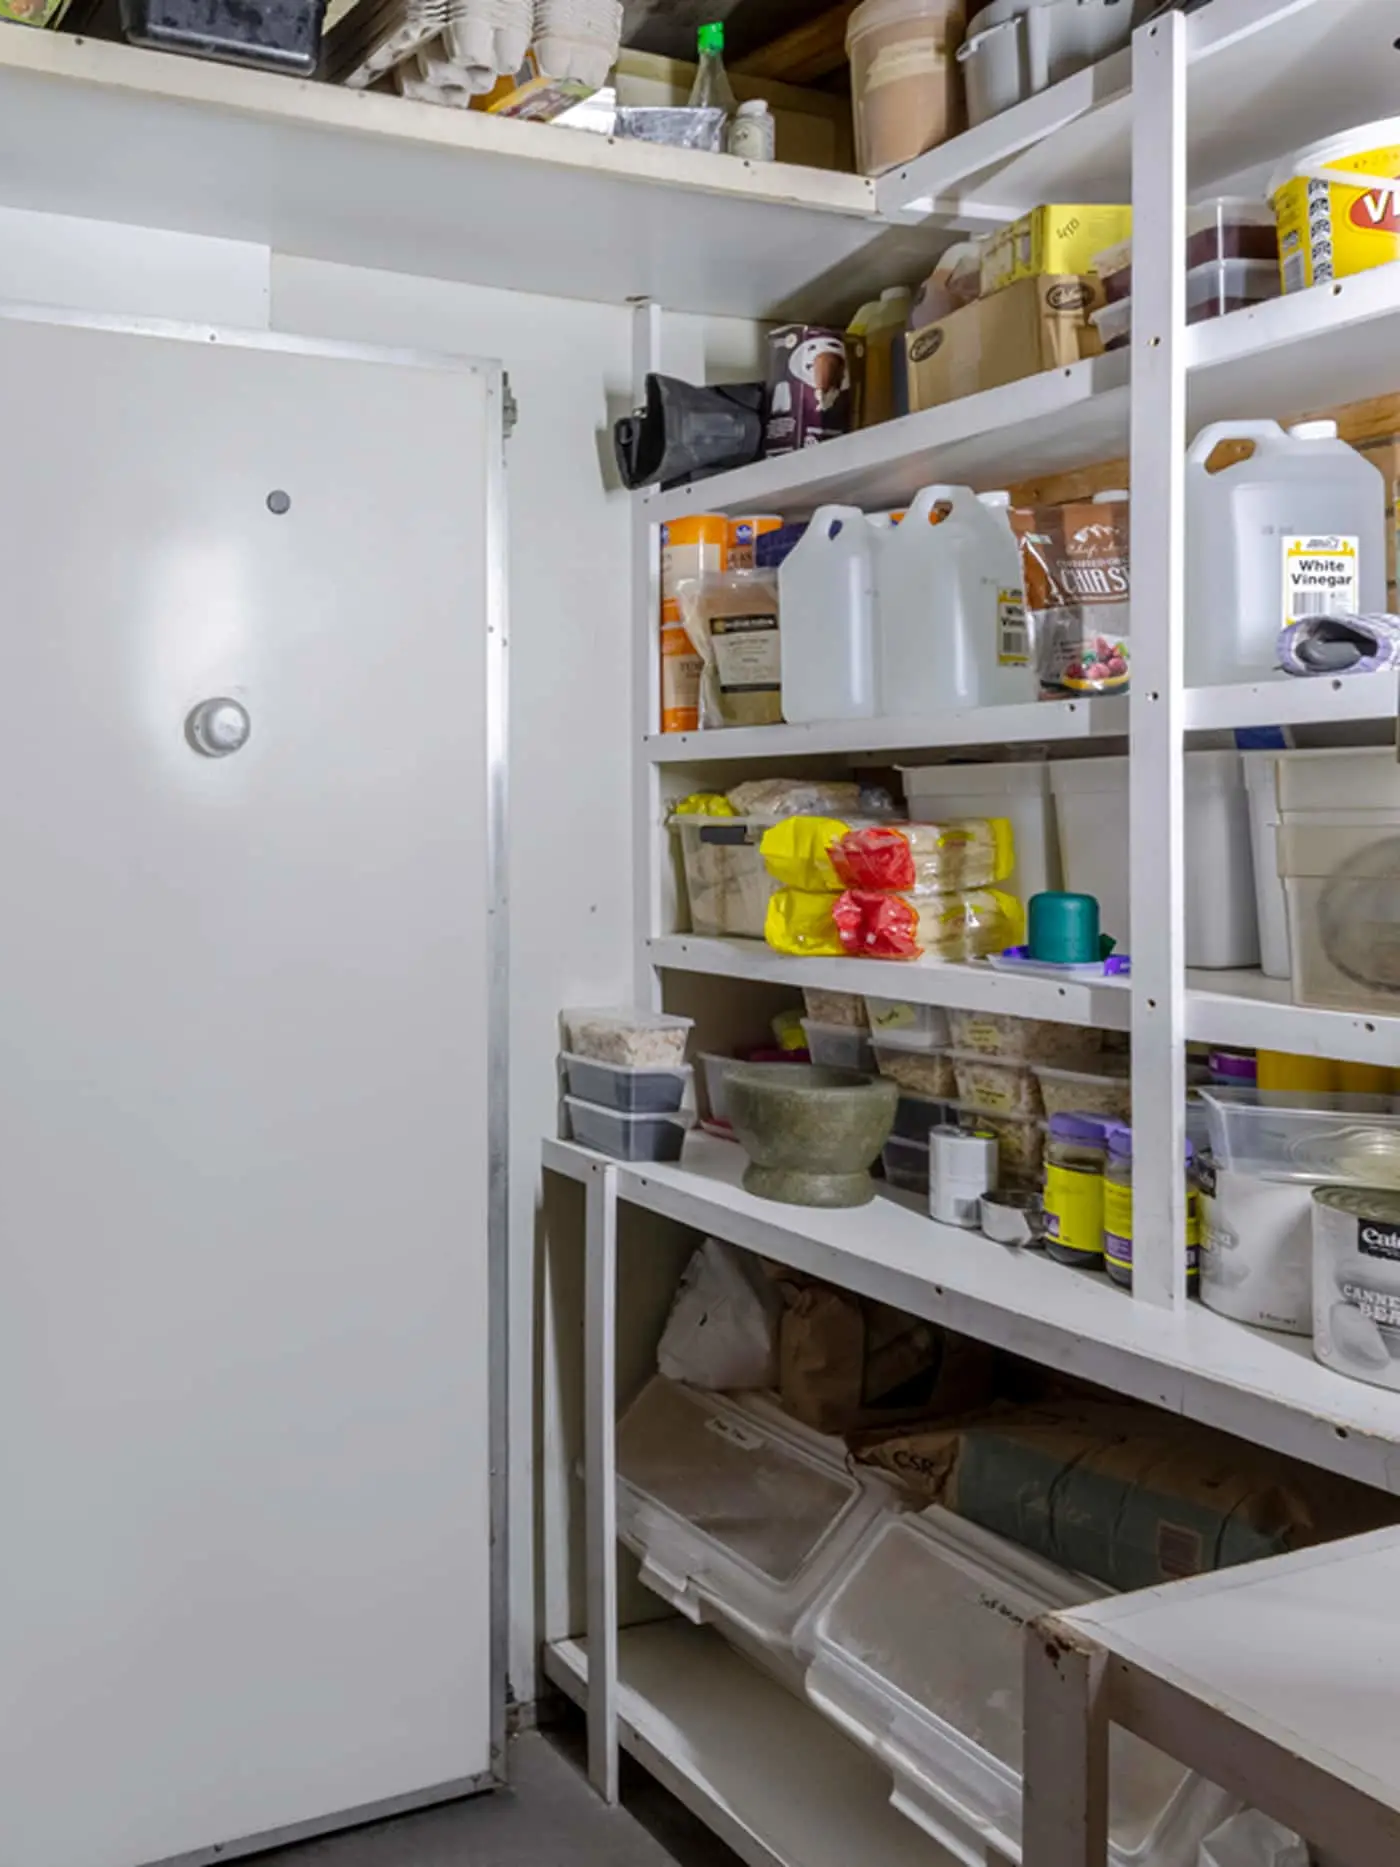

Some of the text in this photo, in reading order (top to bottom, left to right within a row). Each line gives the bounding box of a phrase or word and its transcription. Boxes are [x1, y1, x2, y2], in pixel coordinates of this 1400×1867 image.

[1298, 559, 1346, 572] White
[1291, 573, 1353, 587] Vinegar
[891, 1450, 936, 1478] CSR
